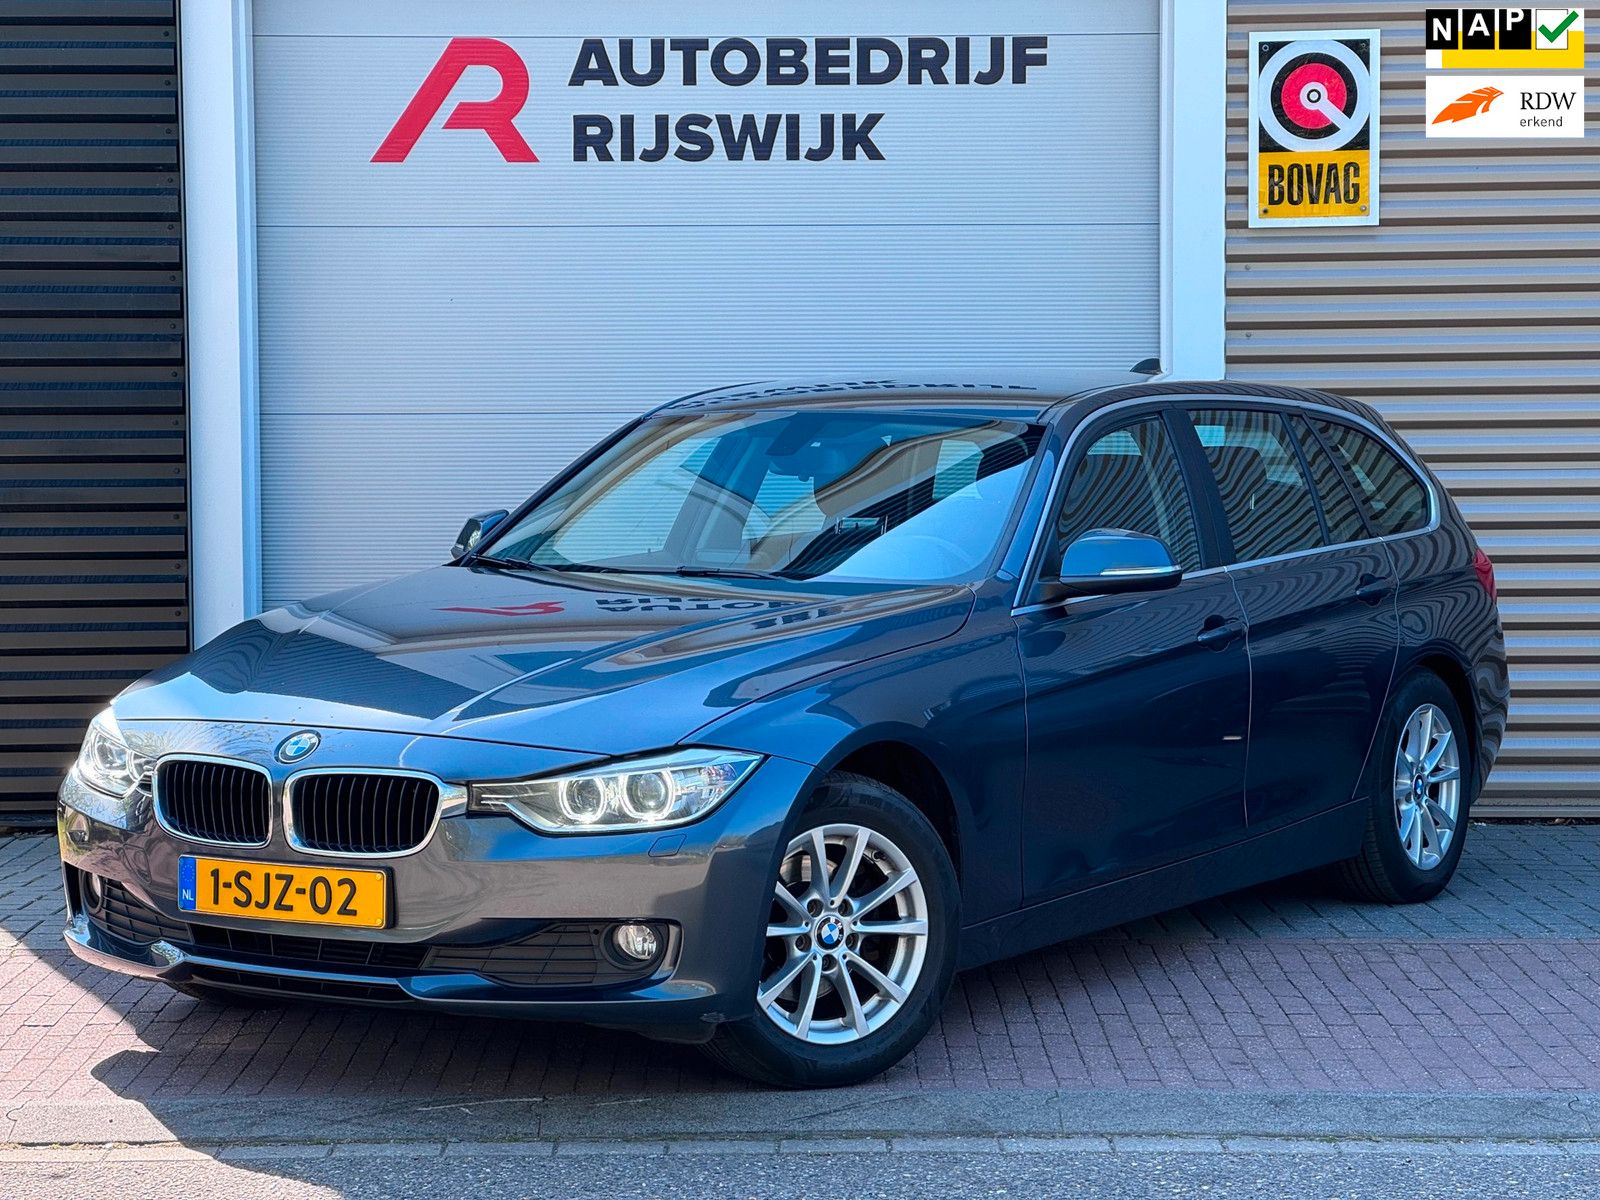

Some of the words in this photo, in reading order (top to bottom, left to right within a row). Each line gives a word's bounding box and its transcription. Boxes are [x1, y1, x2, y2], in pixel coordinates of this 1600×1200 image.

[568, 37, 1048, 86] AUTOBEDRIJF
[572, 113, 886, 162] RIJSWIJK
[1267, 161, 1360, 206] BOVAG
[182, 889, 194, 901] NL
[210, 868, 358, 916] 1-SJZ-02
